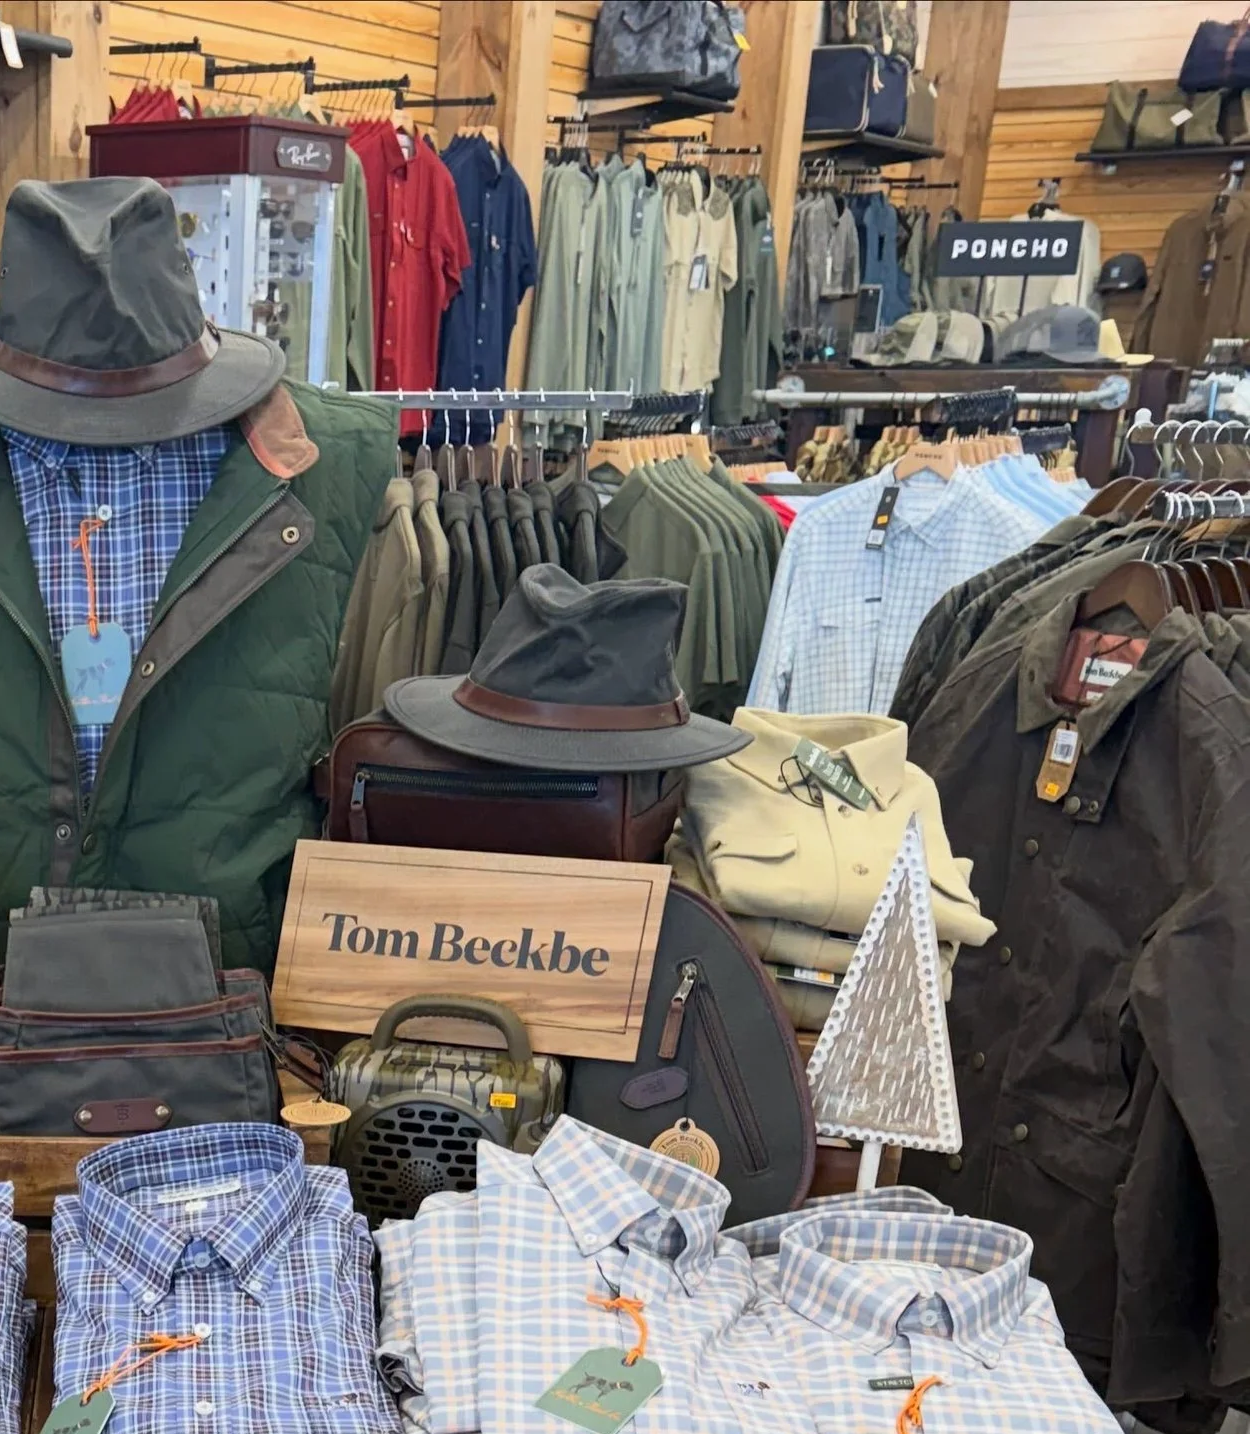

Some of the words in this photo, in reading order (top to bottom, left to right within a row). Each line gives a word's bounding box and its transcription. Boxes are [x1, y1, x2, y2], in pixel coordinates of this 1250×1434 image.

[950, 238, 1068, 259] PONCHO
[322, 913, 419, 959] Tom
[428, 923, 610, 976] Beckbe
